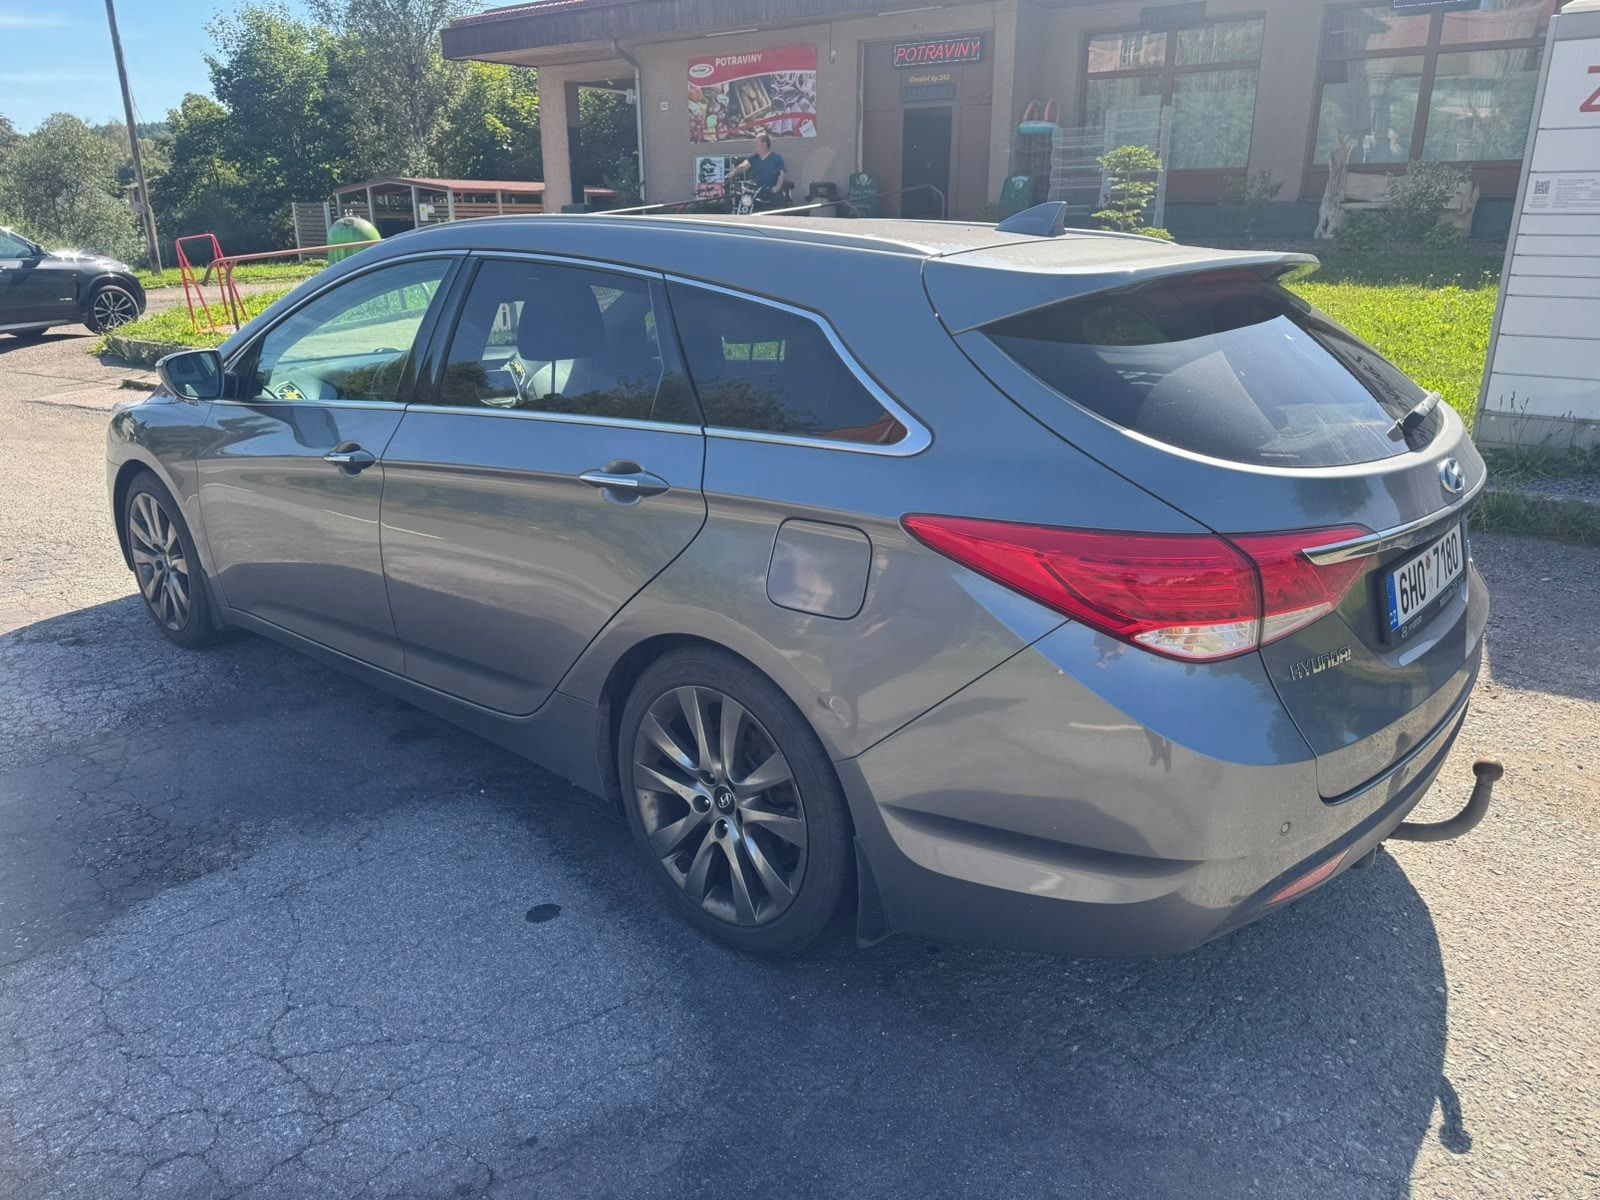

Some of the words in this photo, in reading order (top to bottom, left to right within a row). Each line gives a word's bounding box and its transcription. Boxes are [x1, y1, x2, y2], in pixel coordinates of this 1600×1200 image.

[715, 54, 763, 67] POTRAVINY
[896, 41, 980, 64] POTRAVINY
[1433, 532, 1459, 589] 7180
[1289, 645, 1352, 681] HYUNDAI
